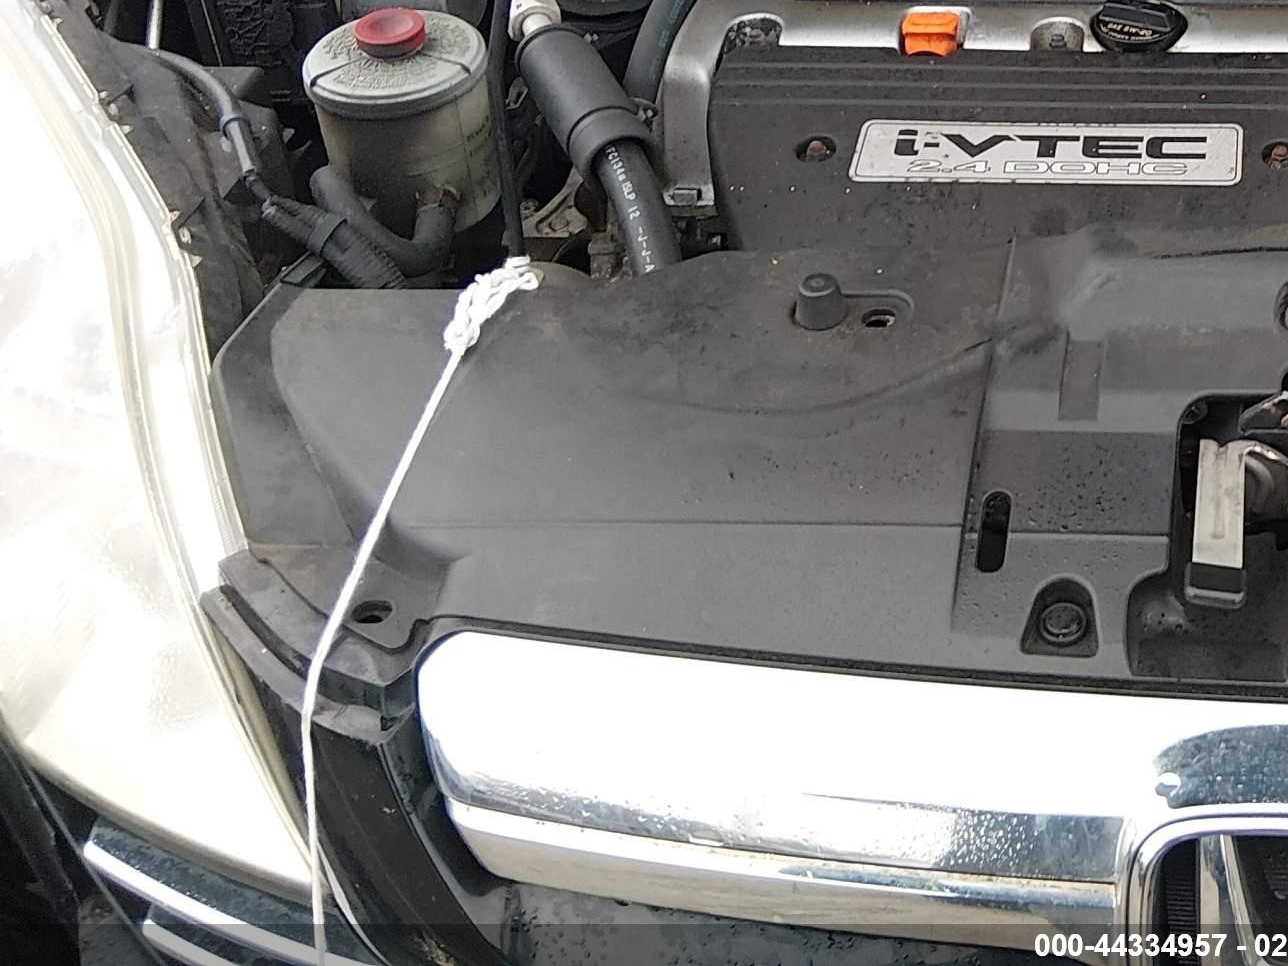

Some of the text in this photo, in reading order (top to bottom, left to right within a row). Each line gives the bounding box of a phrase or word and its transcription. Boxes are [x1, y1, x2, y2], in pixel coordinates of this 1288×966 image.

[893, 129, 1207, 159] i-VTEC
[906, 160, 1188, 176] 2.4 DOHC
